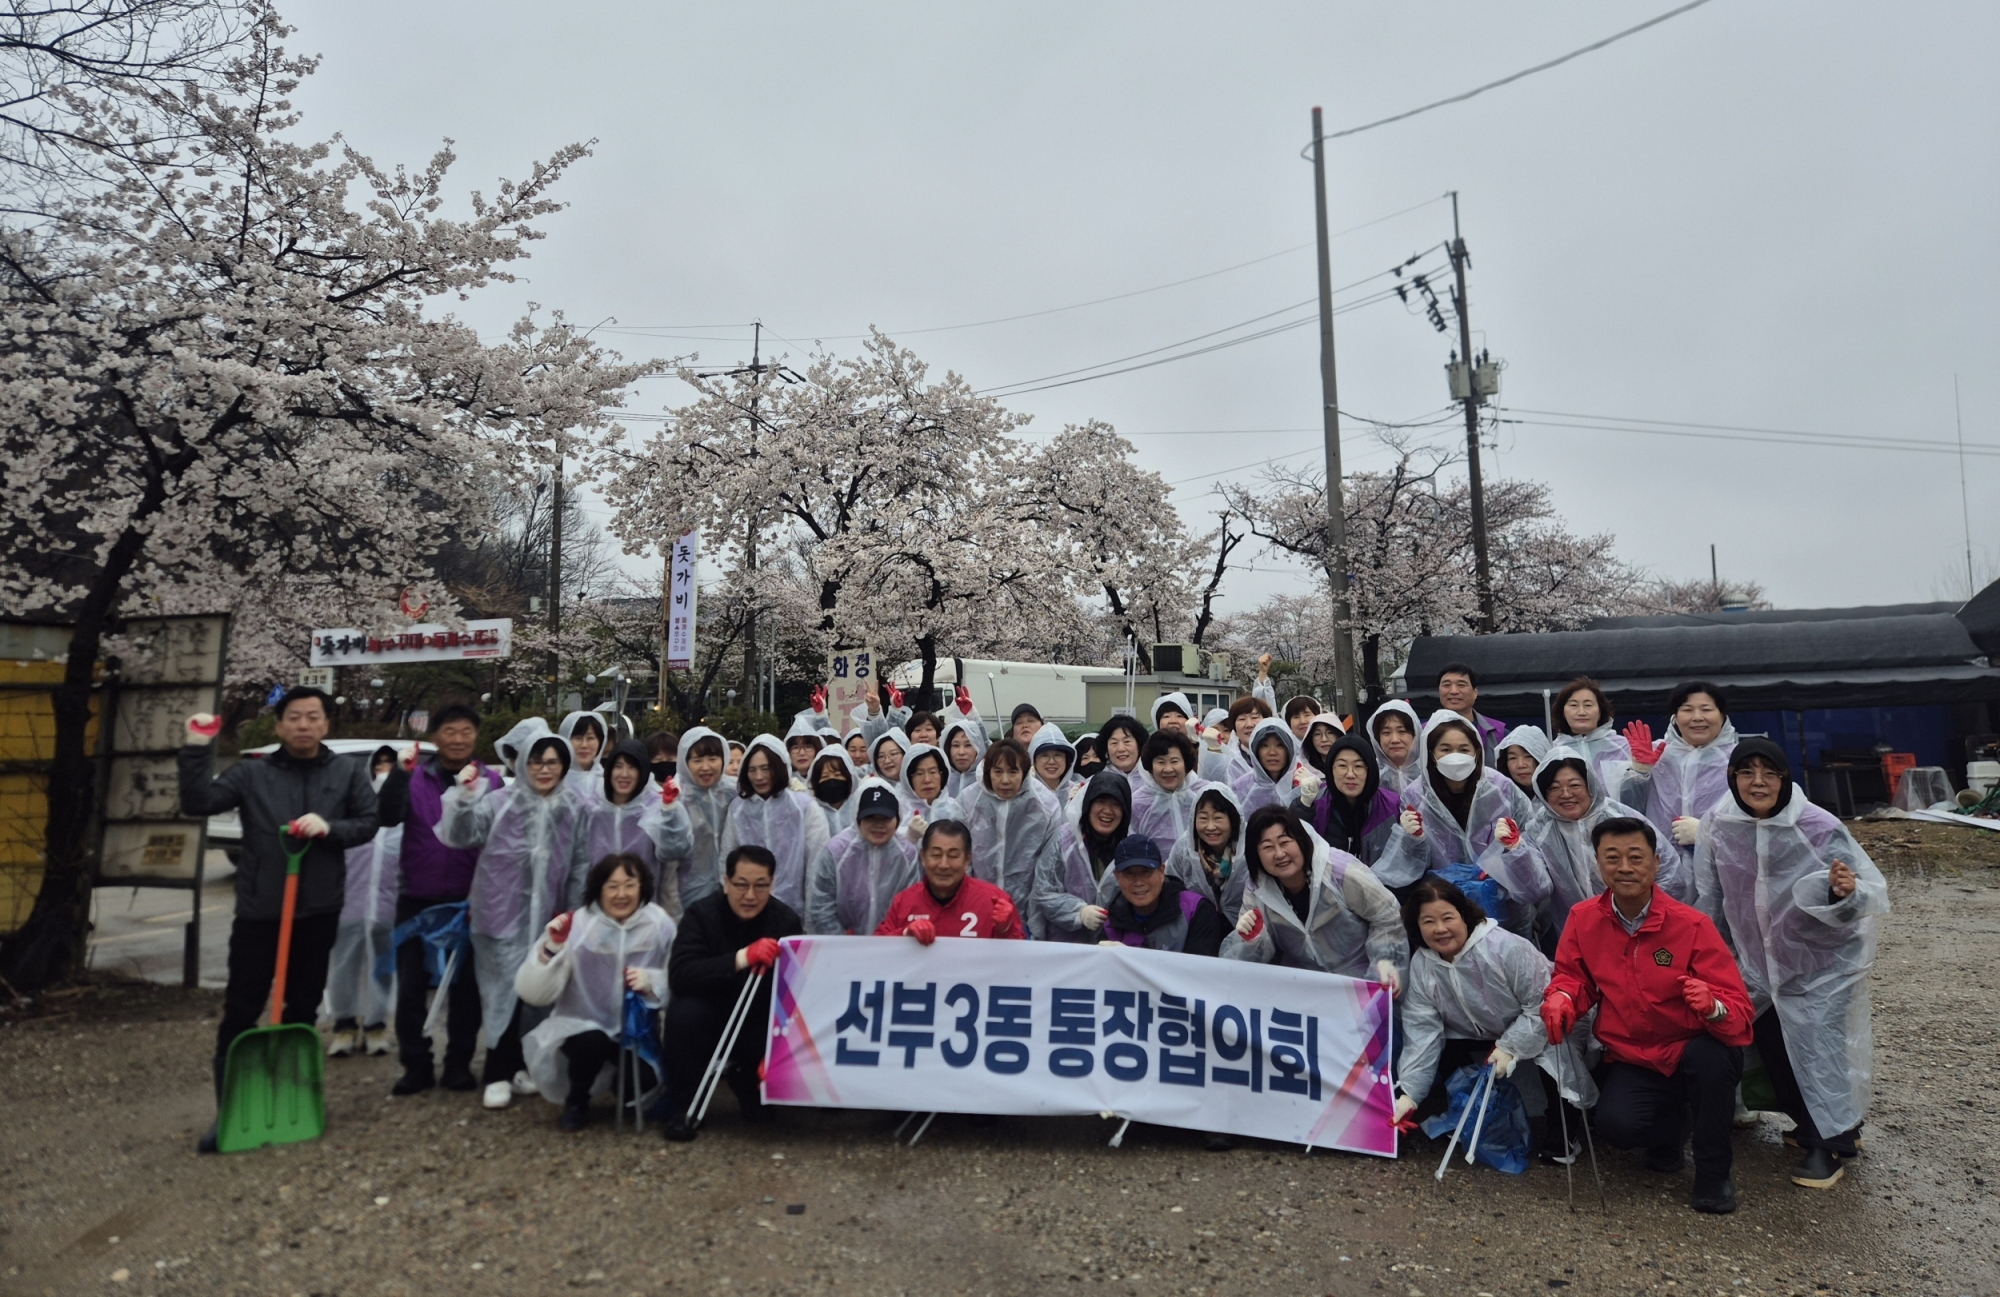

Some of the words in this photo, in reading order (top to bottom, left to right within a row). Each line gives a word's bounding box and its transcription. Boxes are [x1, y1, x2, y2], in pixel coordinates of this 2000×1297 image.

[675, 545, 691, 610] 돗가비
[872, 791, 882, 802] P
[959, 911, 978, 937] 2
[834, 979, 1032, 1075] 선부3동
[1048, 988, 1322, 1101] 통장협의회
